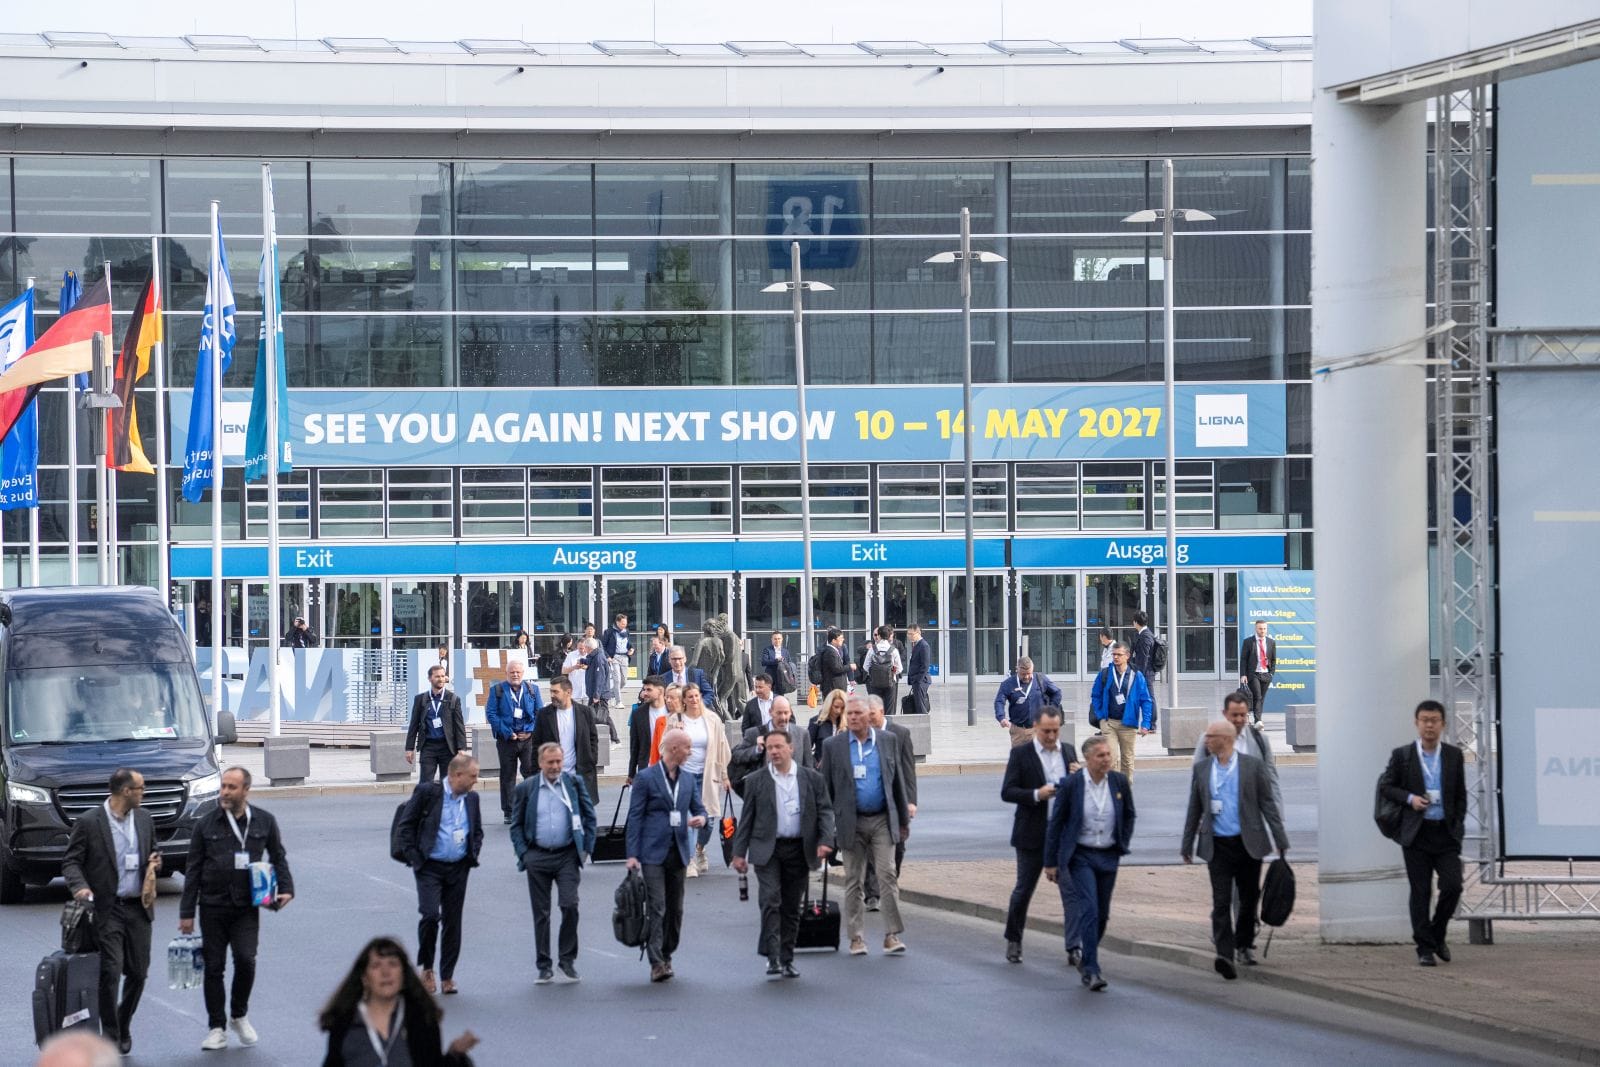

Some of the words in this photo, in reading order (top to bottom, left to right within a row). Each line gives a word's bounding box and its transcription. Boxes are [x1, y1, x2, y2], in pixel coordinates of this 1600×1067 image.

[304, 413, 366, 444] SEE
[375, 412, 456, 444] YOU
[467, 411, 602, 442] AGAIN!
[614, 411, 711, 442] NEXT
[720, 410, 836, 441] SHOW
[855, 410, 895, 440] 10
[984, 408, 1068, 438] MAY
[1079, 407, 1162, 438] 2027
[1198, 415, 1245, 426] LIGNA
[295, 550, 334, 568] Exit
[552, 547, 637, 571] Ausgang
[851, 543, 888, 561] Exit
[1106, 541, 1190, 564] Ausgag
[1249, 610, 1297, 618] LIGNA.Stage
